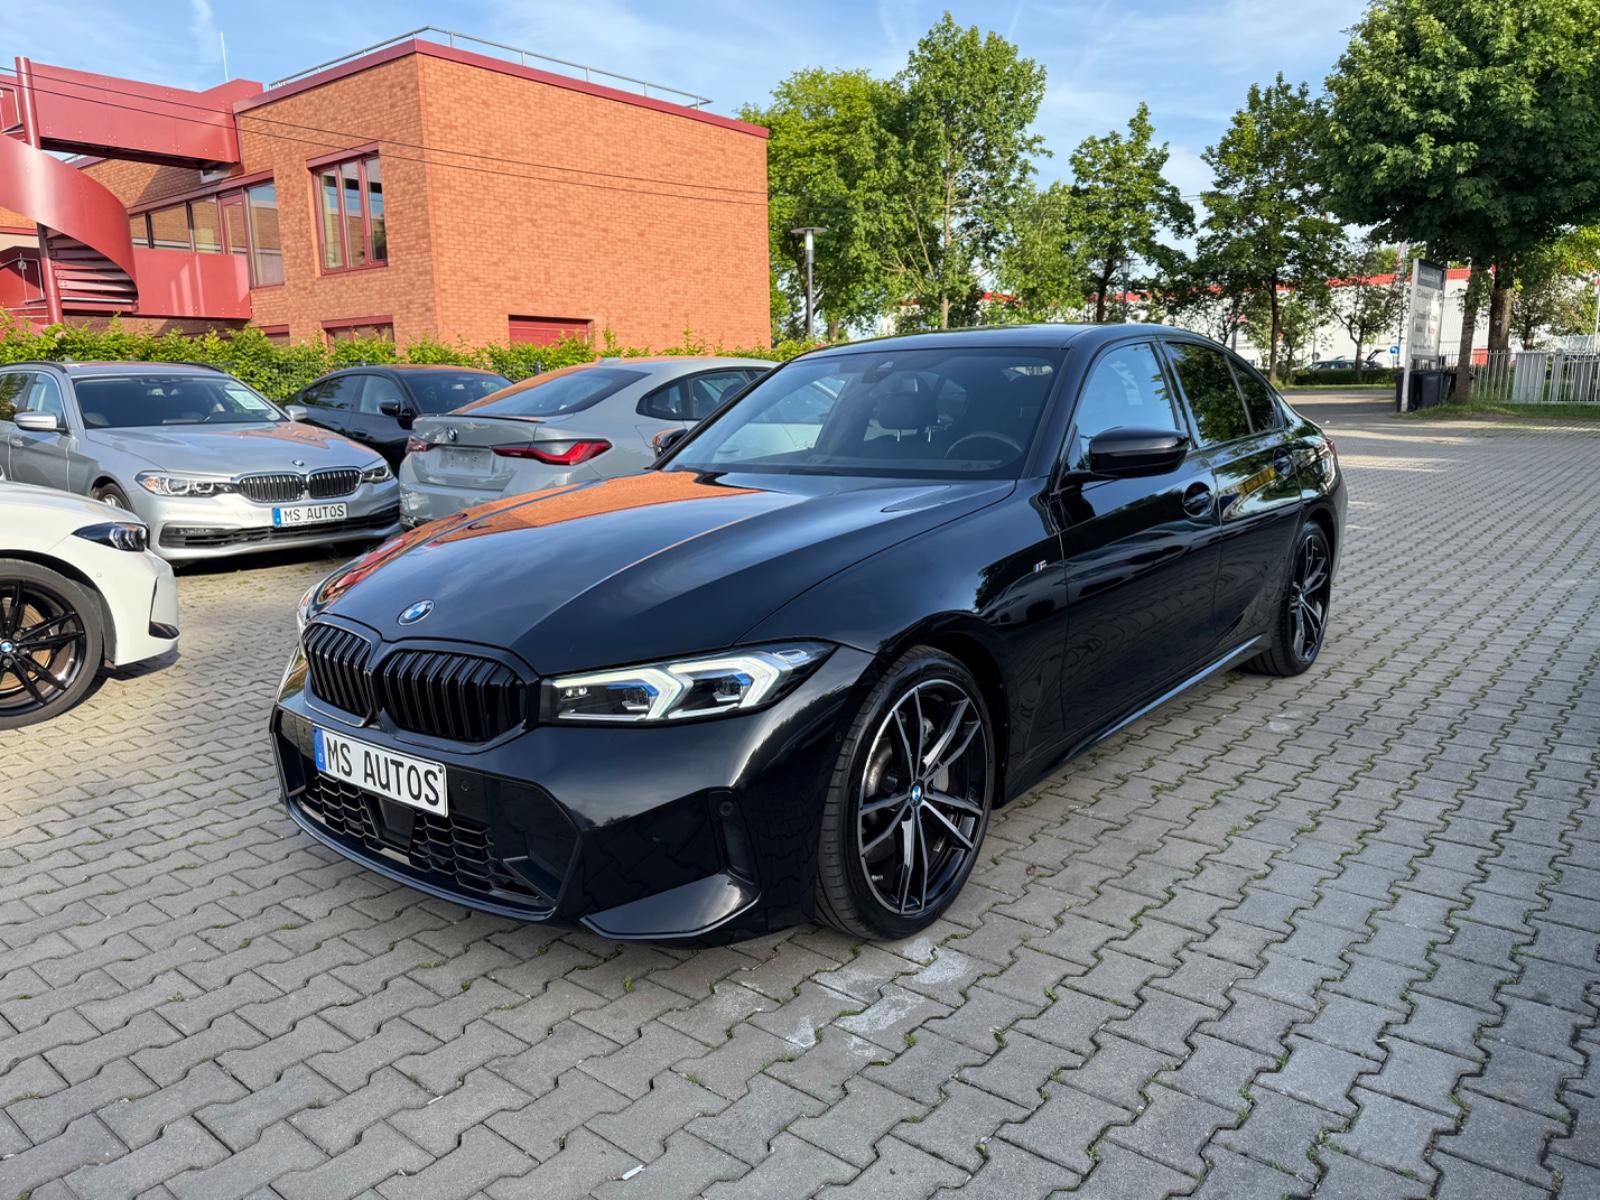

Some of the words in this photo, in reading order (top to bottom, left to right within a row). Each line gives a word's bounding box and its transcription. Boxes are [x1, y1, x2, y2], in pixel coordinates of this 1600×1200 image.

[284, 509, 300, 521] MS
[307, 505, 344, 519] AUTOS
[326, 736, 352, 777] MS
[363, 750, 440, 806] AUTOS
